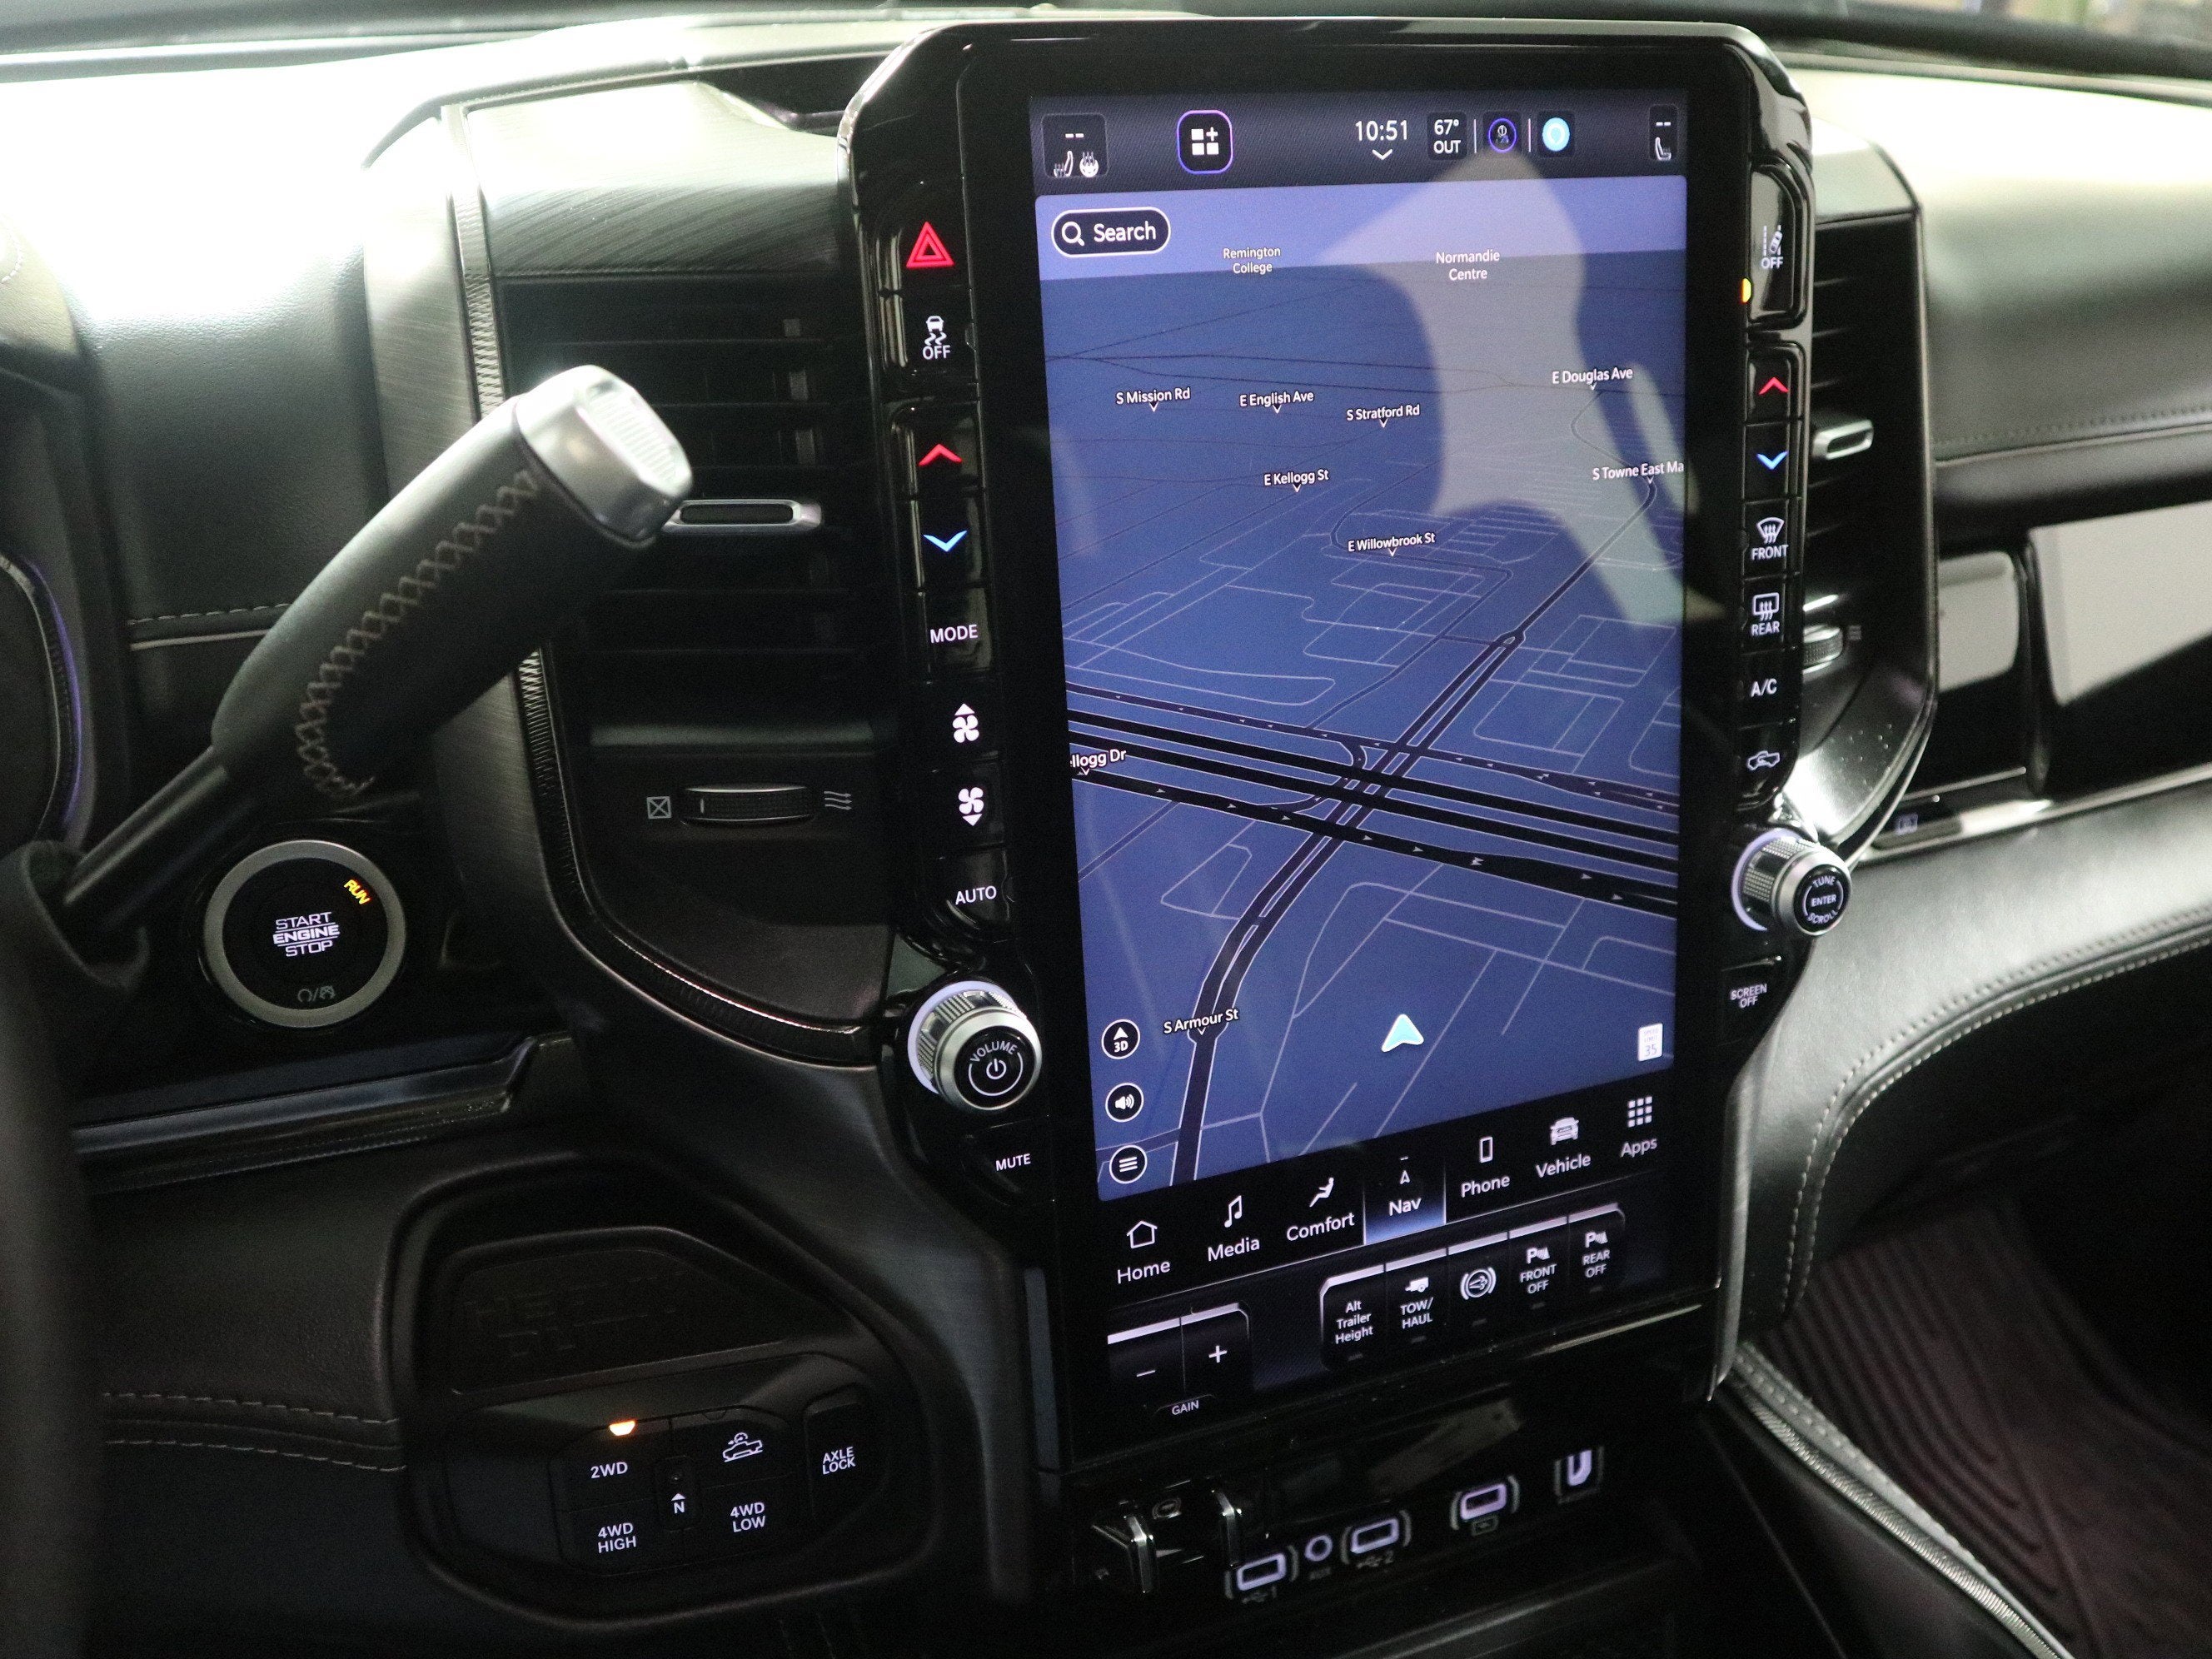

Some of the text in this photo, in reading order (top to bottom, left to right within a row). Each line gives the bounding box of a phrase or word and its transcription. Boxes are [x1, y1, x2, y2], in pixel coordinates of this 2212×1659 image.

[1355, 119, 1408, 142] 10:51
[1433, 139, 1462, 155] OUT
[1093, 221, 1157, 242] Search
[1223, 247, 1281, 260] Remington
[1436, 249, 1500, 265] Normandie
[1233, 262, 1273, 275] College
[1760, 256, 1784, 269] OFF
[1448, 267, 1487, 281] Centre
[922, 344, 951, 361] OFF
[1552, 366, 1633, 384] E Douglas Ave
[1115, 386, 1191, 405] S Mission Rd
[1239, 391, 1314, 407] E English Ave
[1346, 404, 1420, 421] S Stratford Rd
[1263, 469, 1329, 486] E Kellogg St
[1592, 461, 1685, 481] S Towne East Ma
[1348, 532, 1436, 552] E Willowbrook St
[1751, 544, 1789, 560] FRONT
[929, 624, 979, 644] MODE
[1751, 621, 1781, 636] REAR
[1751, 678, 1778, 697] A/C
[1109, 749, 1127, 763] Dr
[1812, 875, 1837, 888] TUNE
[343, 879, 371, 904] RUN
[954, 885, 998, 905] AUTO
[1811, 894, 1837, 908] ENTER
[275, 911, 332, 931] START
[1806, 909, 1838, 925] SCROLL
[272, 924, 341, 944] ENGINE
[285, 939, 334, 958] STOP
[1730, 984, 1768, 1001] SCREEN
[1738, 997, 1759, 1009] OFF
[1163, 1008, 1239, 1034] S Armour St
[969, 1040, 1019, 1064] VOLUME
[1113, 1040, 1128, 1054] 3D
[1621, 1137, 1658, 1158] Apps
[995, 1153, 1032, 1172] MUTE
[1536, 1153, 1592, 1178] Vehicle
[1461, 1174, 1511, 1198] Phone
[1388, 1197, 1422, 1216] Nav
[1286, 1212, 1356, 1242] Comfort
[1208, 1236, 1261, 1262] Media
[1582, 1249, 1611, 1266] REAR
[1117, 1260, 1171, 1284] Home
[1519, 1263, 1557, 1283] FRONT
[1585, 1263, 1607, 1278] OFF
[1527, 1279, 1549, 1294] OFF
[1345, 1300, 1362, 1313] Alt
[1400, 1297, 1434, 1316] TOW/
[1336, 1313, 1372, 1330] Trailer
[1401, 1313, 1433, 1329] HAUL
[1335, 1325, 1374, 1344] Height
[1171, 1400, 1199, 1416] GAIN
[822, 1447, 854, 1465] AXLE
[590, 1462, 628, 1479] 2WD
[822, 1456, 856, 1475] LOCK
[674, 1502, 685, 1514] N
[730, 1502, 765, 1518] 4WD
[597, 1522, 634, 1539] 4WD
[732, 1515, 766, 1532] LOW
[597, 1536, 636, 1553] HIGH
